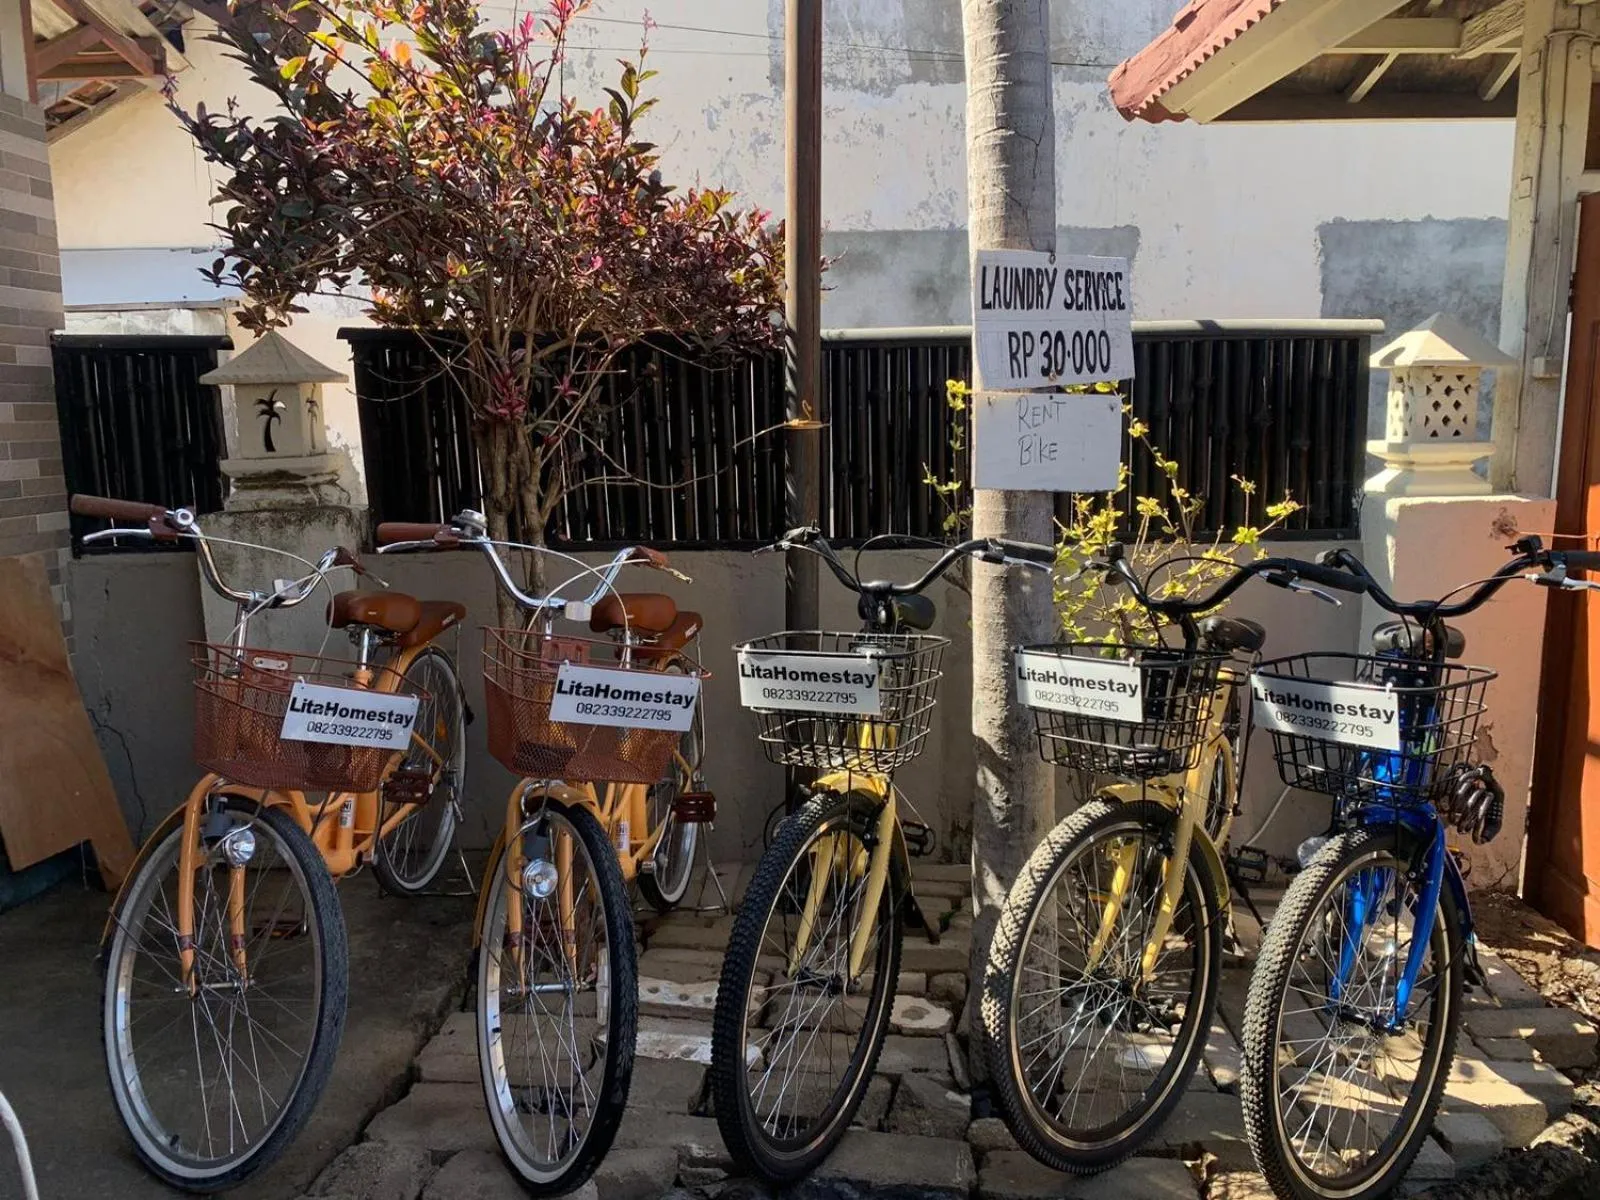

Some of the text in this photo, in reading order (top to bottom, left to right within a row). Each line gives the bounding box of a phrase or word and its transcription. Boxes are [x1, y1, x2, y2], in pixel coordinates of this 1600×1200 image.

[981, 265, 1126, 311] LAUNDRY SERVICE
[1016, 394, 1067, 432] RENT
[740, 664, 876, 689] LitaHomestay
[1018, 666, 1139, 698] LitaHomestay
[556, 679, 695, 709] LitaHomestay
[763, 688, 858, 704] 082339222795
[1035, 689, 1119, 713] 082339222795
[1254, 687, 1395, 724] LitaHomestay
[289, 696, 414, 728] LitaHomestay
[576, 702, 672, 721] 082339222795
[1275, 710, 1373, 738] 082339222795
[306, 721, 393, 741] 082339222795
